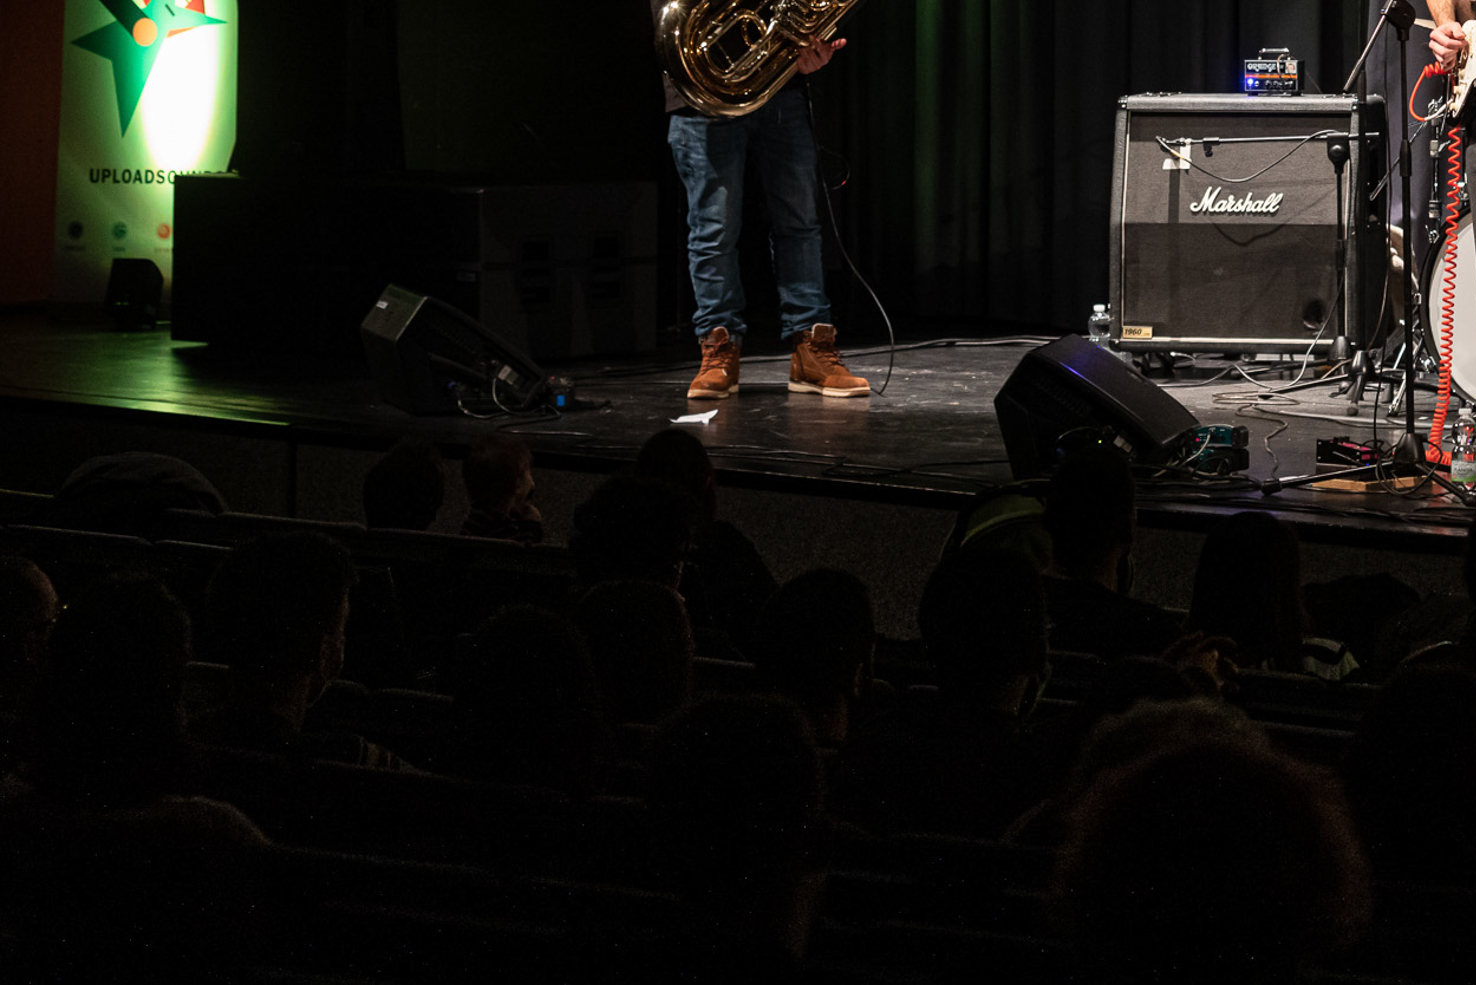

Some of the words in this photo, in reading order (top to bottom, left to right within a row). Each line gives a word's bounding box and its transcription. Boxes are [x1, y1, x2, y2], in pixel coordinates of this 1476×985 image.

[89, 168, 224, 185] UPLOADSO
[1189, 186, 1283, 213] Marshall
[1124, 328, 1143, 336] 1960
